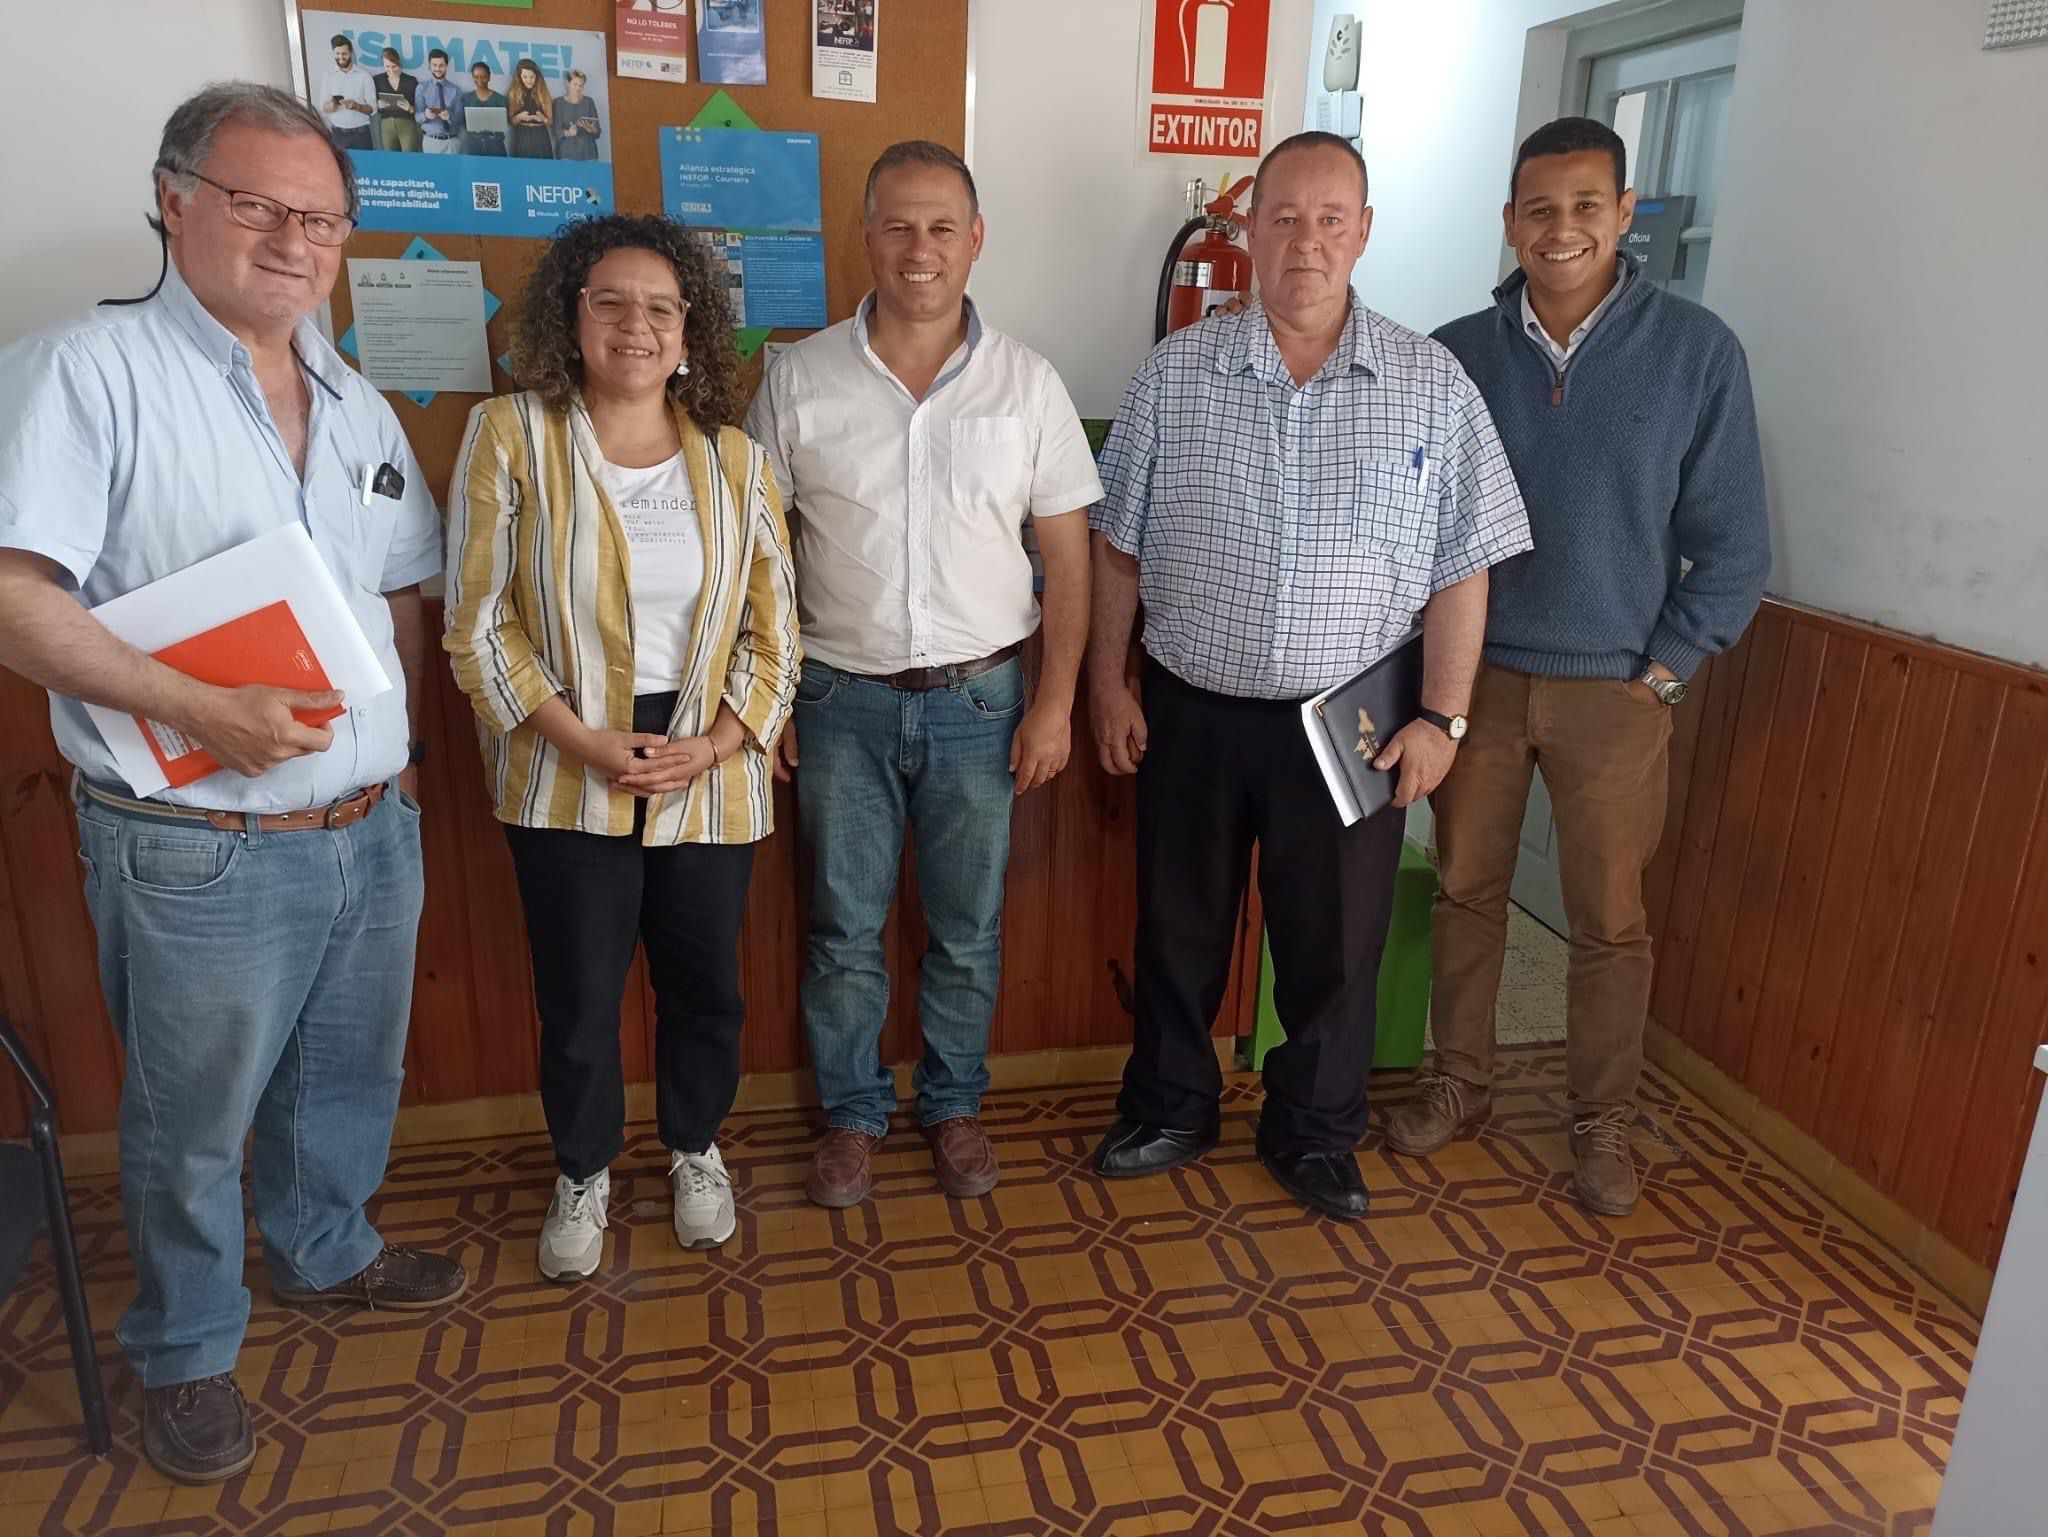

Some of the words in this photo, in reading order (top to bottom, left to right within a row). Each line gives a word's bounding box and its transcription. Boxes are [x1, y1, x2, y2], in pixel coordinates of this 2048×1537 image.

[1152, 113, 1257, 147] EXTINTOR
[680, 163, 709, 173] Alianza
[680, 173, 709, 182] INEFOP
[380, 179, 436, 189] capacitarte
[407, 190, 449, 200] digitales
[526, 184, 583, 205] INEFOP
[371, 199, 440, 209] empleabilidad
[1628, 232, 1650, 243] Oficina
[621, 498, 696, 510] reminder
